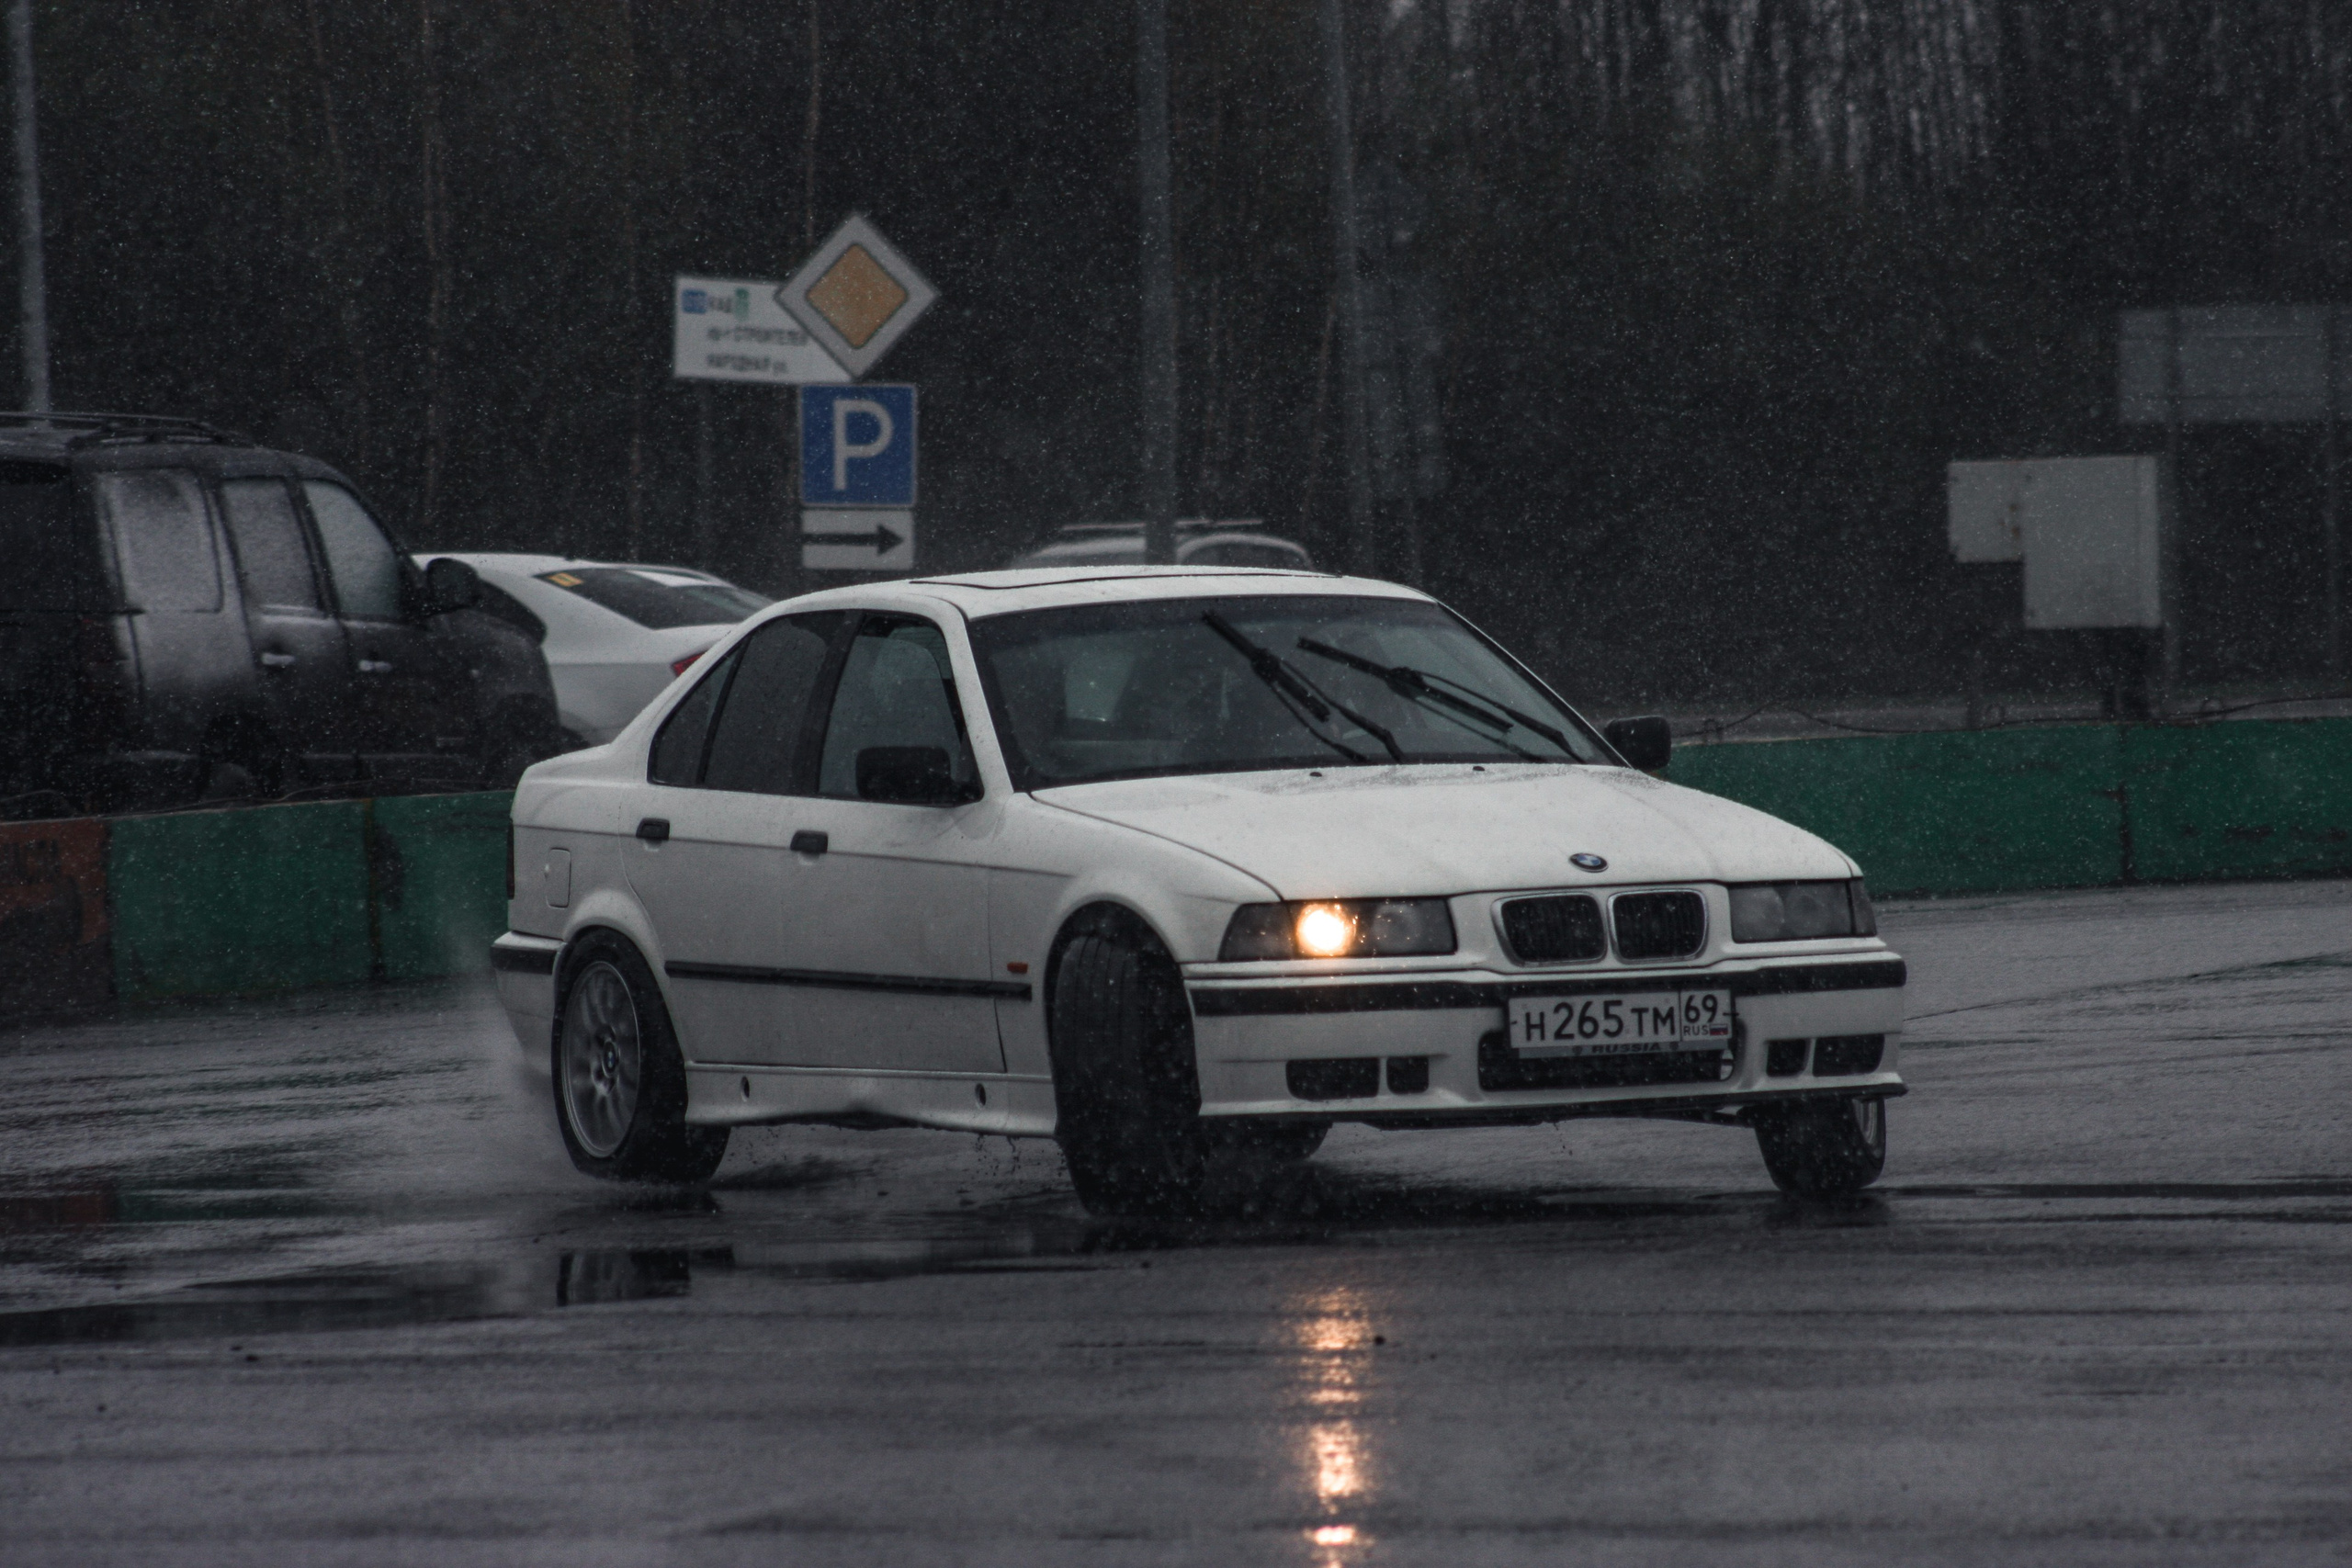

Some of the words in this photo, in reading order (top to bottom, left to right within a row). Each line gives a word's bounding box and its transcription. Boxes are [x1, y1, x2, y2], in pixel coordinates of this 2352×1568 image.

[832, 399, 894, 491] P
[1684, 994, 1718, 1024] 69
[1683, 1024, 1709, 1036] RUS
[1591, 1042, 1661, 1054] RUSSIA
